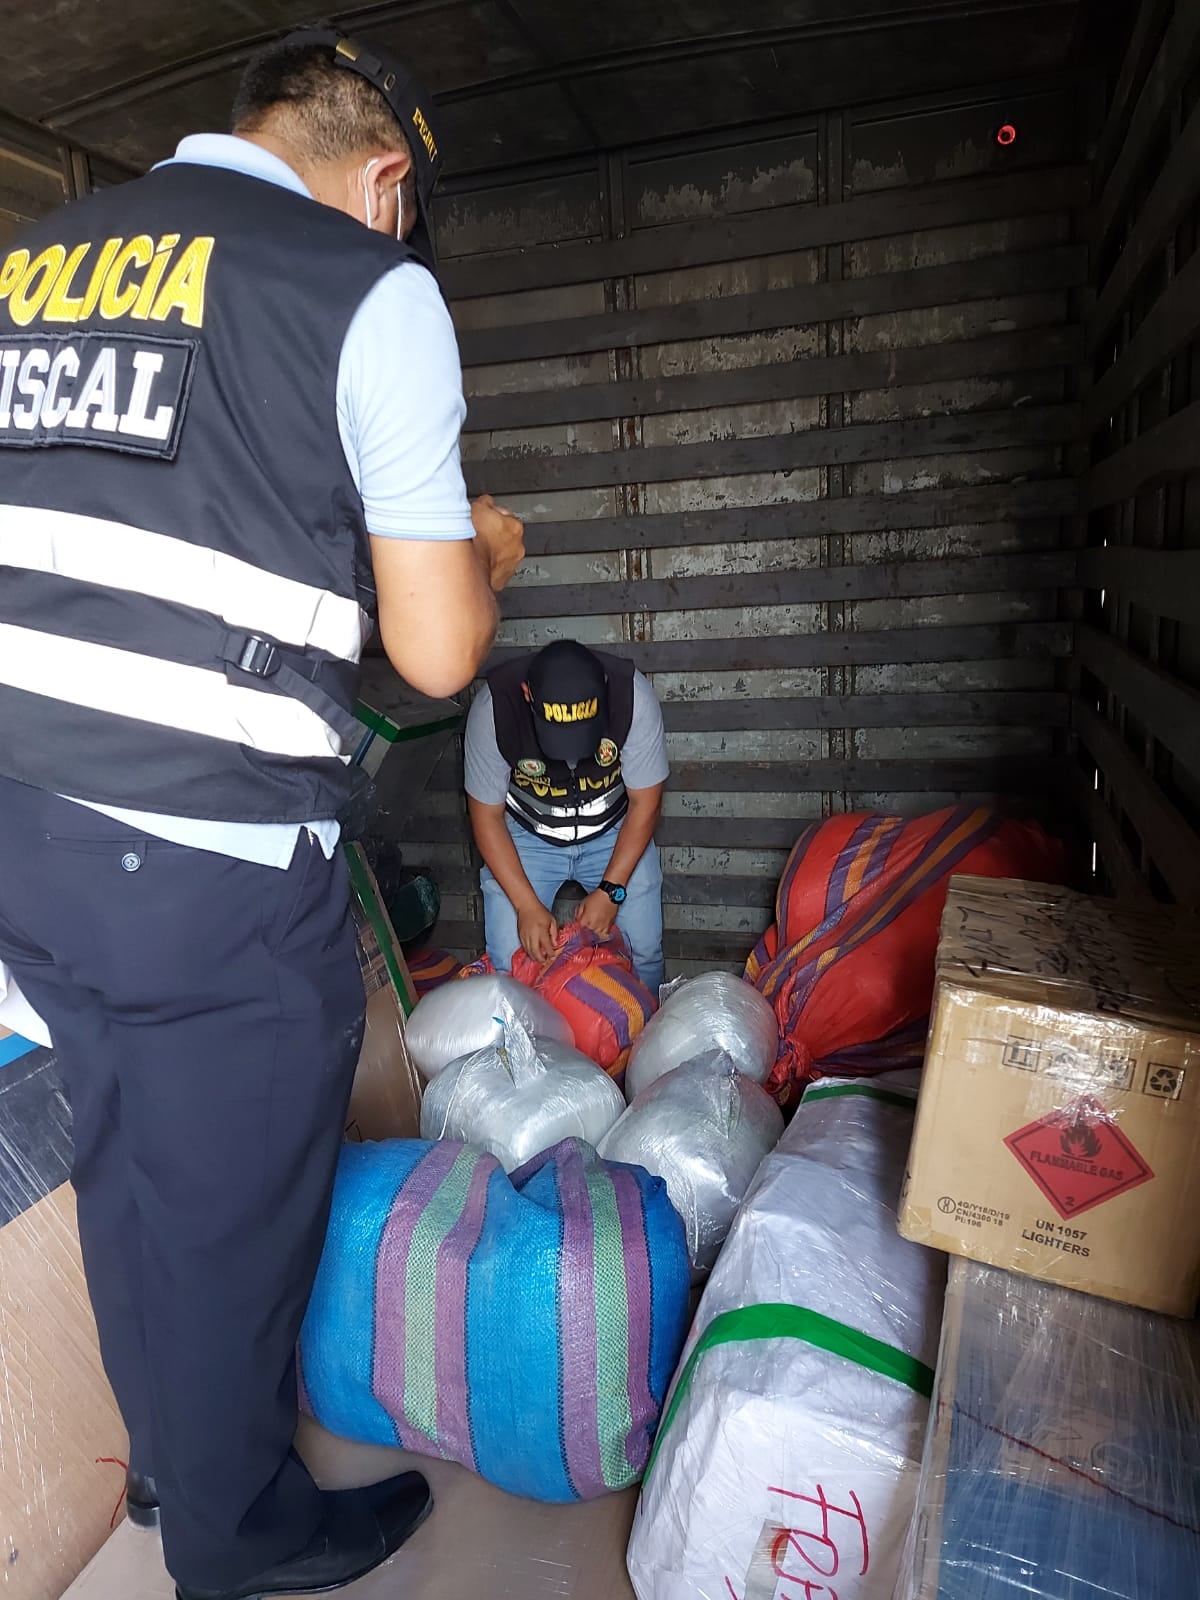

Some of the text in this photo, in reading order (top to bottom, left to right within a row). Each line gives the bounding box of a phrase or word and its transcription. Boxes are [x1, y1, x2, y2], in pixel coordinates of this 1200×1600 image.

[0, 346, 174, 440] ISCAL
[1030, 1150, 1124, 1181] FLAMMABLE GAS
[1064, 1195, 1076, 1207] 2
[1021, 1228, 1091, 1258] LIGHTERS
[1035, 1219, 1088, 1241] UN 1057
